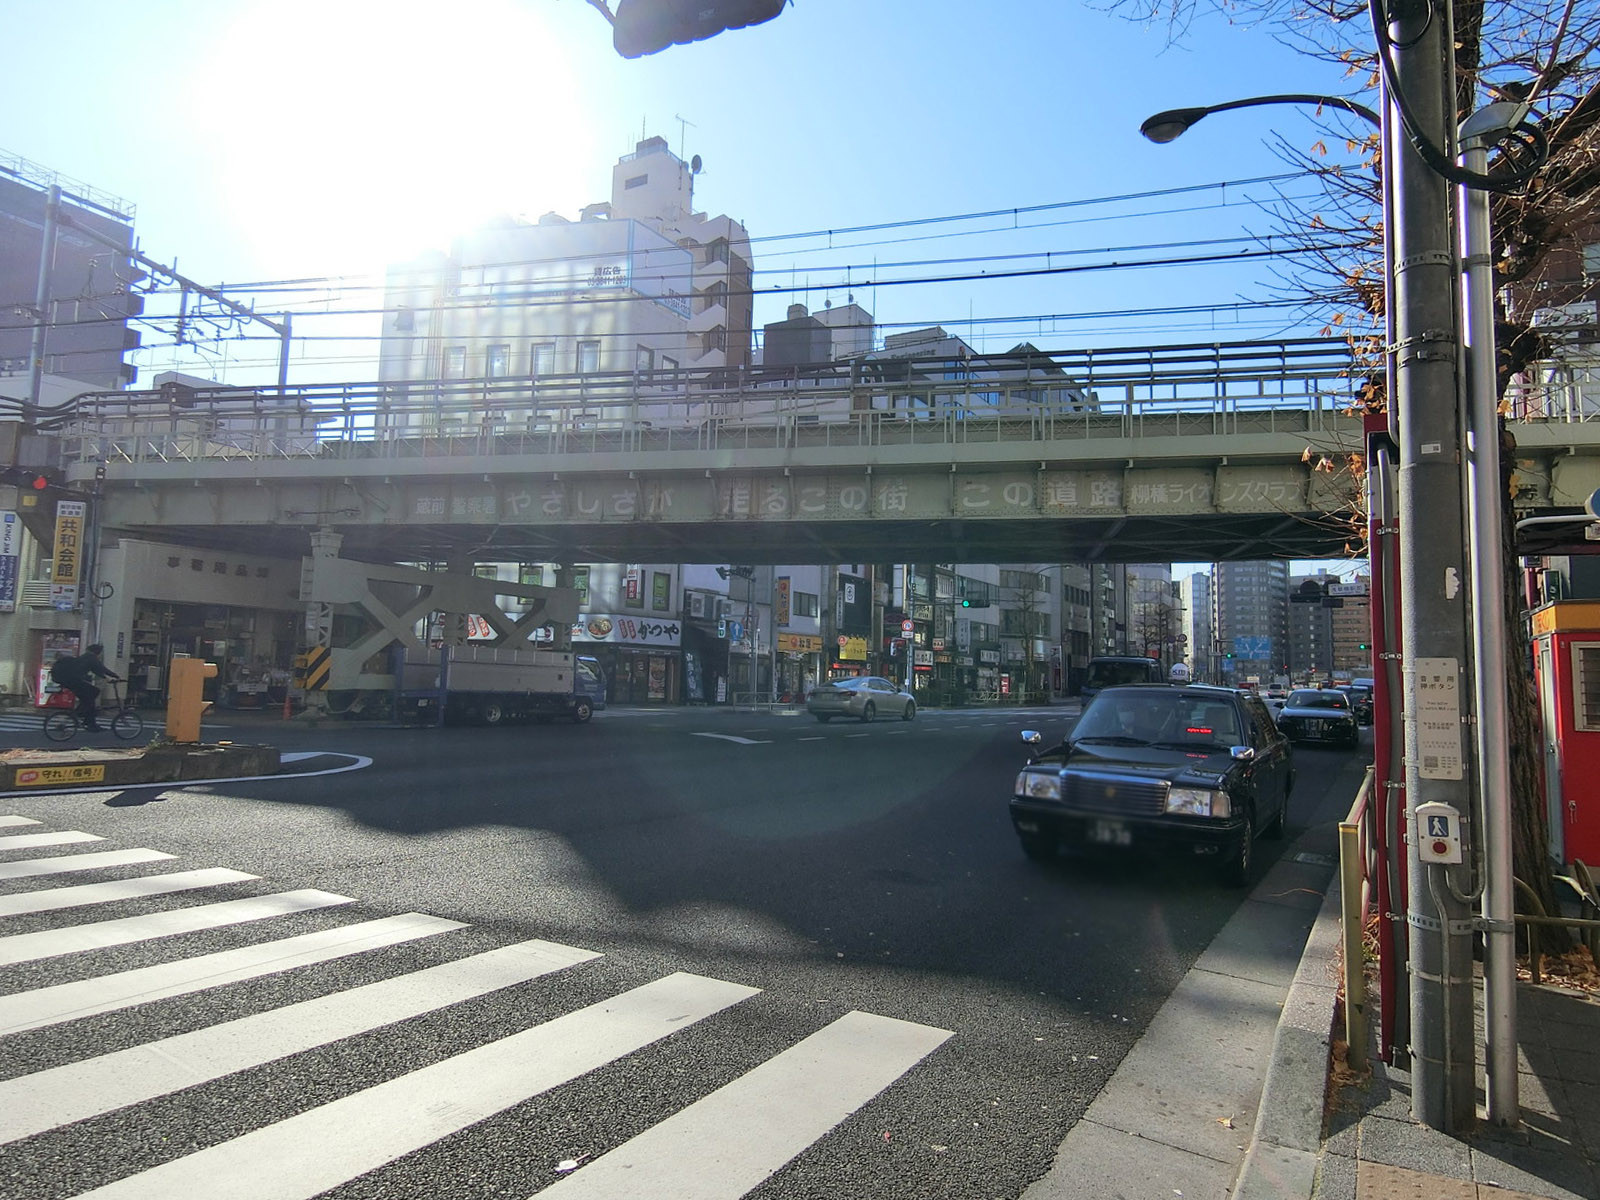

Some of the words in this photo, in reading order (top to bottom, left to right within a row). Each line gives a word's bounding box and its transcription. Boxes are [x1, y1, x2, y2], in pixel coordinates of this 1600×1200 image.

[962, 479, 1123, 509] この道路
[57, 519, 78, 577] 共和会館
[637, 620, 680, 640] かつや
